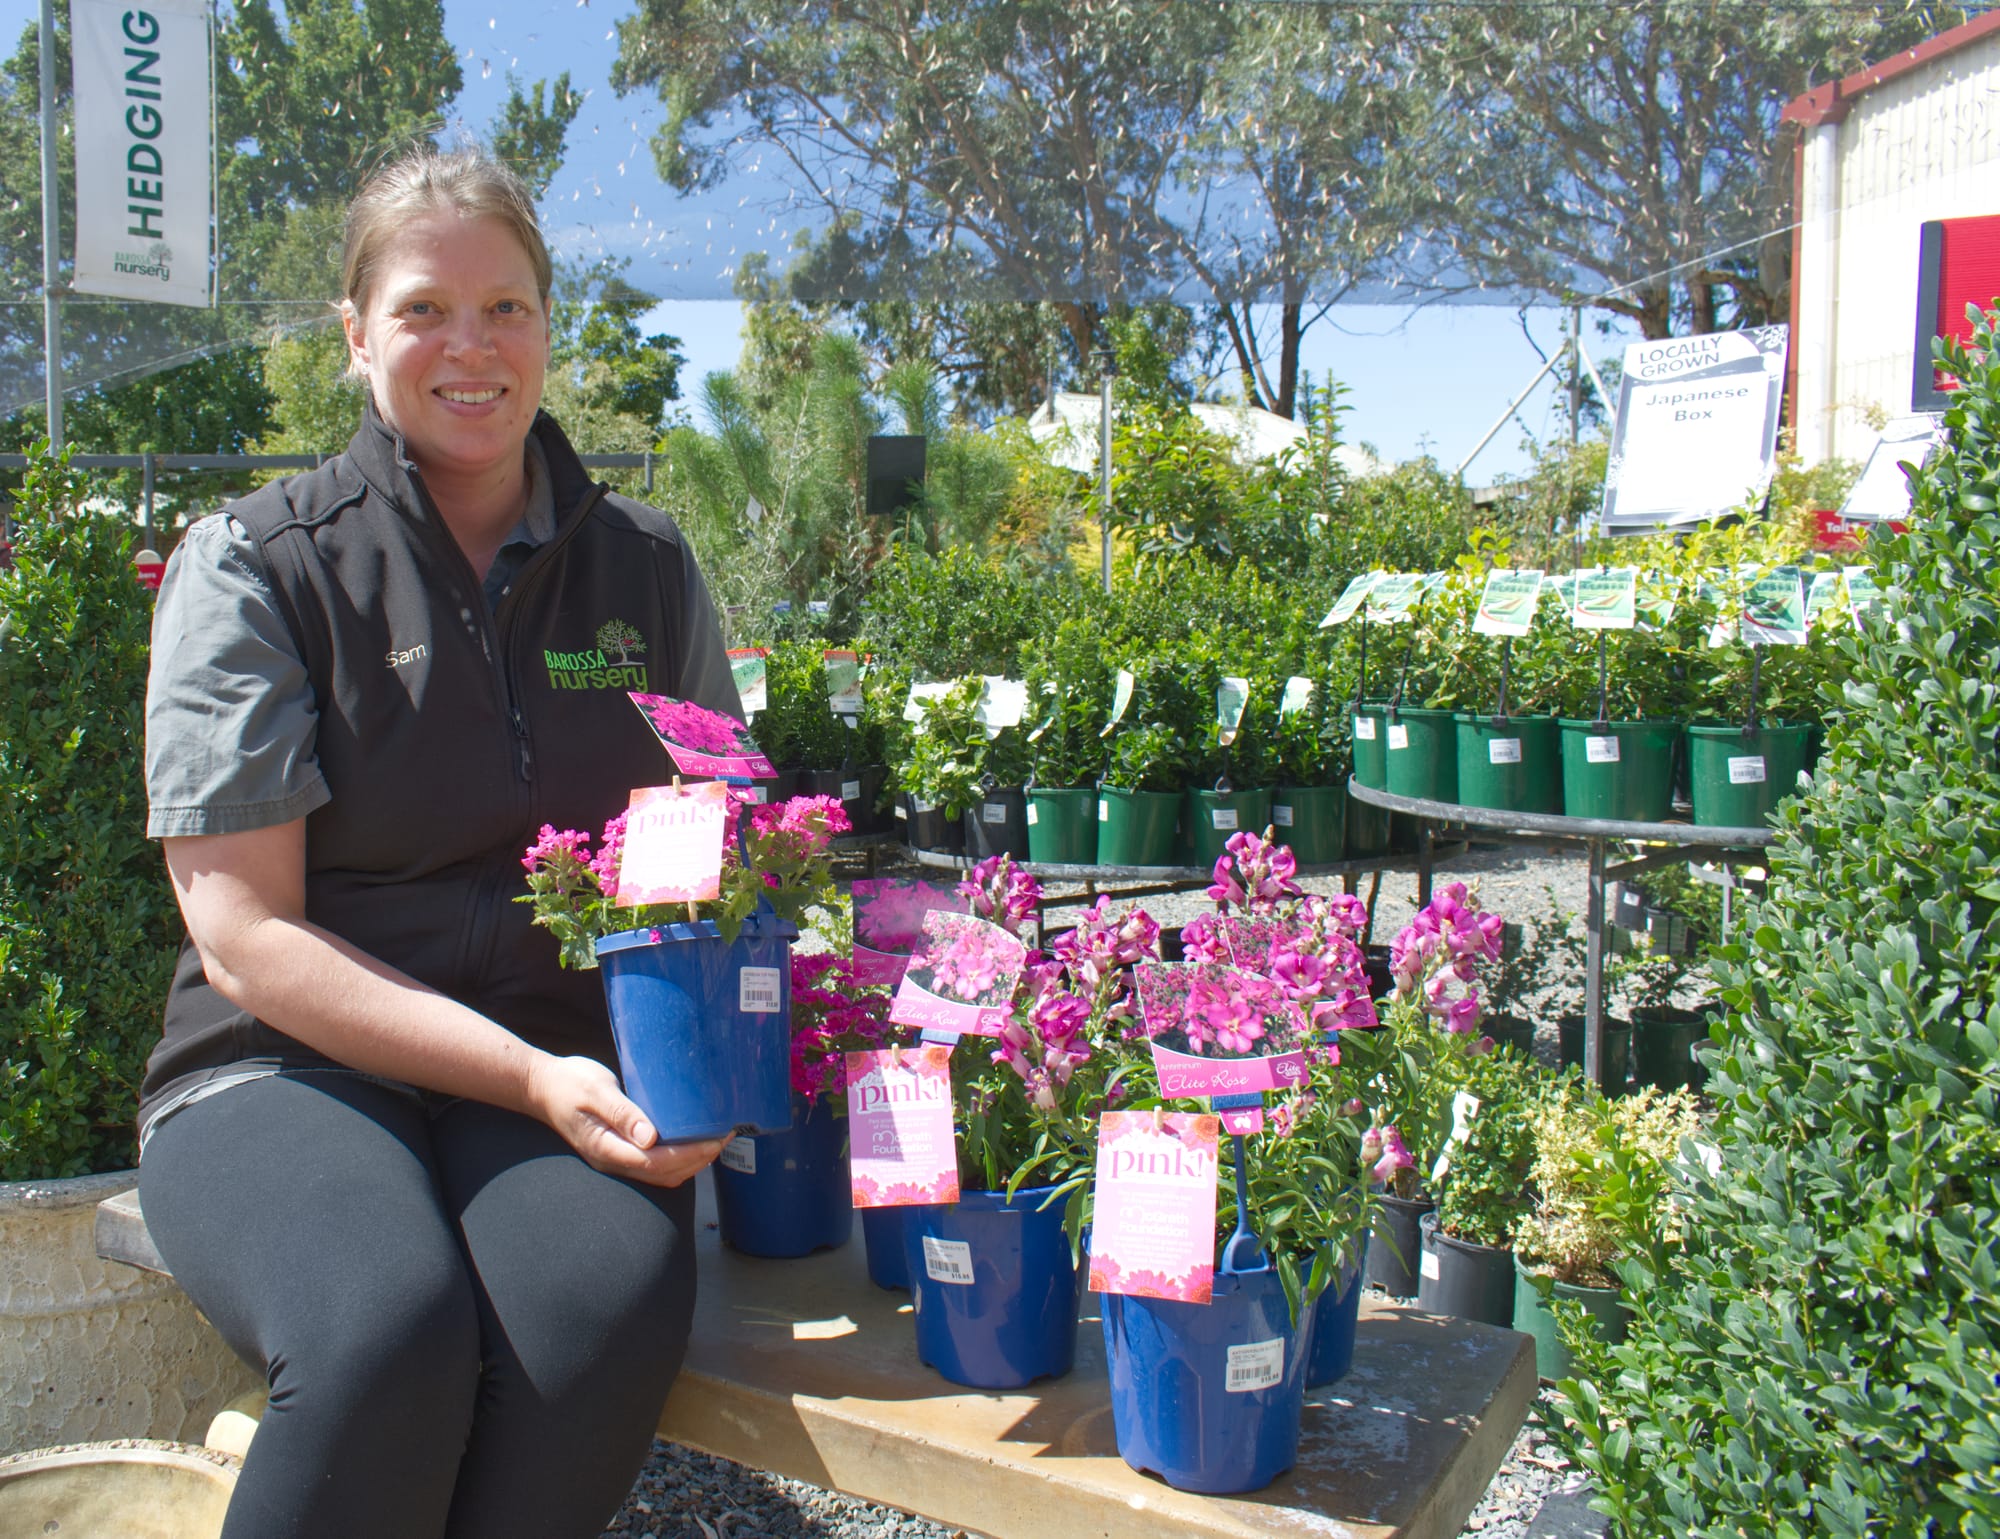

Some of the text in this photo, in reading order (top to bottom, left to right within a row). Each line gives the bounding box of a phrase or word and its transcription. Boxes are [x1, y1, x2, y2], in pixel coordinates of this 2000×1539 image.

[121, 10, 163, 239] HEDGING
[114, 251, 151, 266] BAROSSA
[114, 262, 170, 282] nursery
[1640, 336, 1722, 364] LOCALLY
[1641, 352, 1719, 377] GROWN
[1646, 387, 1749, 406] Japanese
[1674, 410, 1713, 422] Box
[1825, 522, 1849, 533] Tall
[385, 644, 427, 668] Sam
[544, 649, 608, 670] BAROSSA
[550, 666, 649, 693] nursery
[895, 1003, 961, 1026] Elite Rose
[1166, 1070, 1249, 1092] Elite Rose
[860, 1076, 939, 1111] pink!
[1111, 1148, 1204, 1179] pink!
